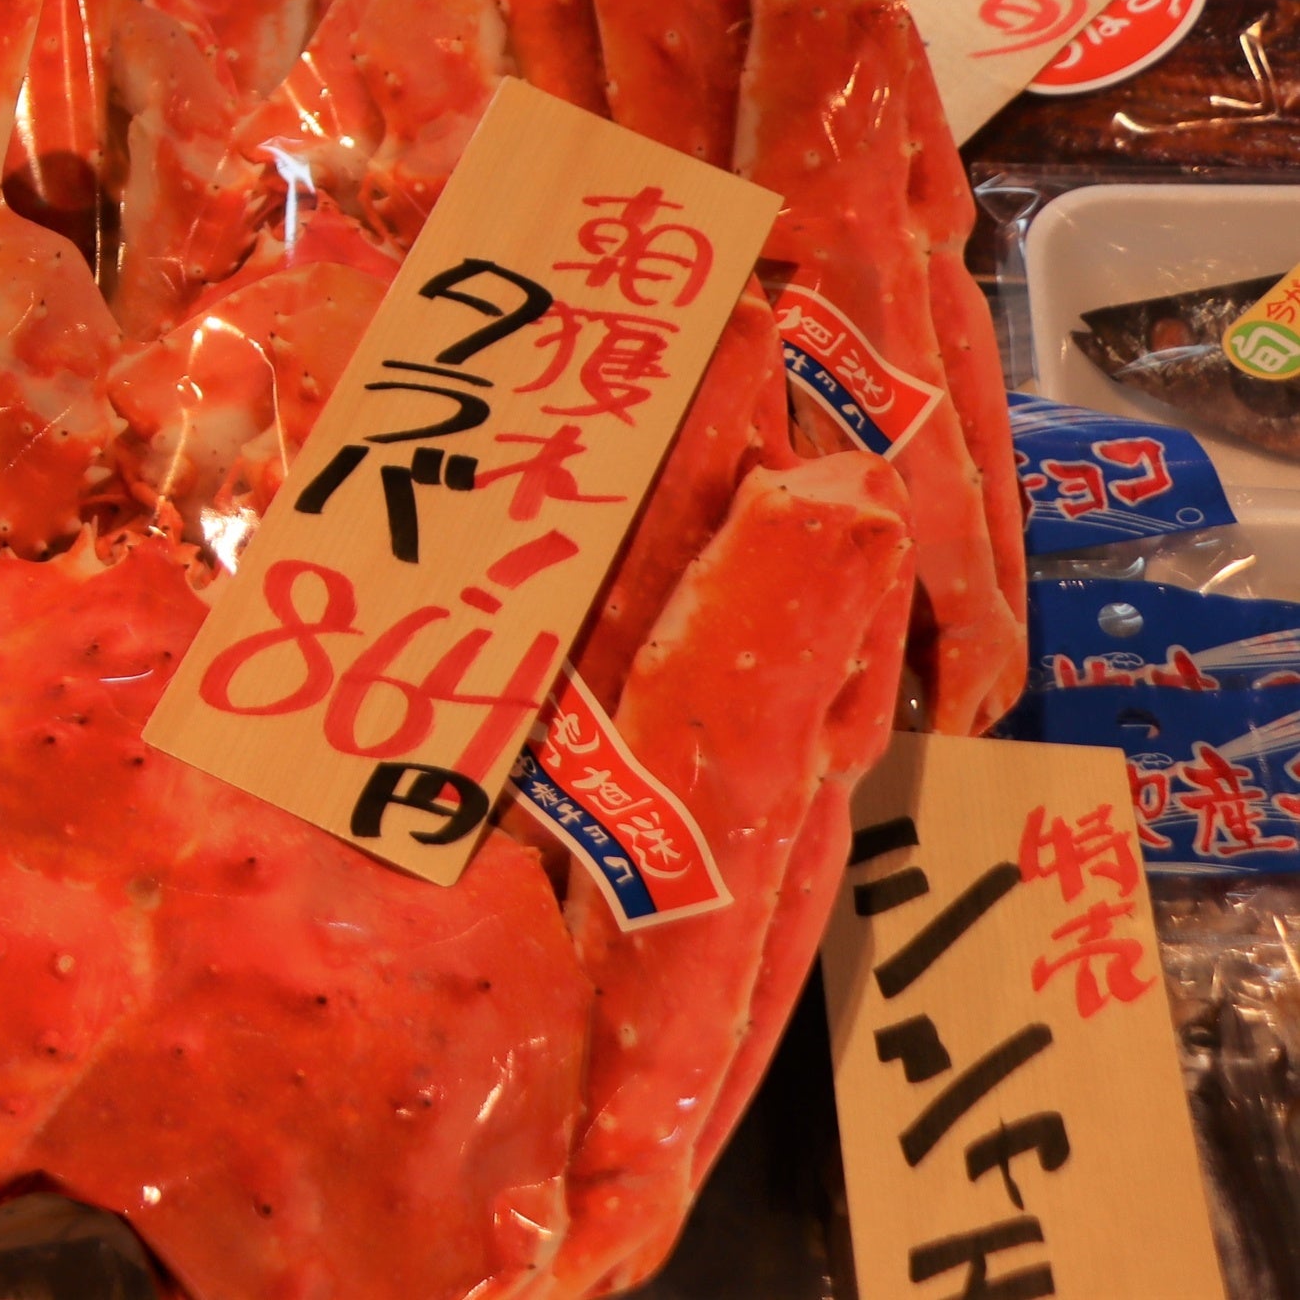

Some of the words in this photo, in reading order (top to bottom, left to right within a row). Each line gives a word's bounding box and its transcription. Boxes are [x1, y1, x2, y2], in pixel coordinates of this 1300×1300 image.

[295, 258, 556, 564] タラバ
[199, 559, 564, 803] 864
[351, 761, 491, 847] 円
[1018, 802, 1158, 1020] 特売
